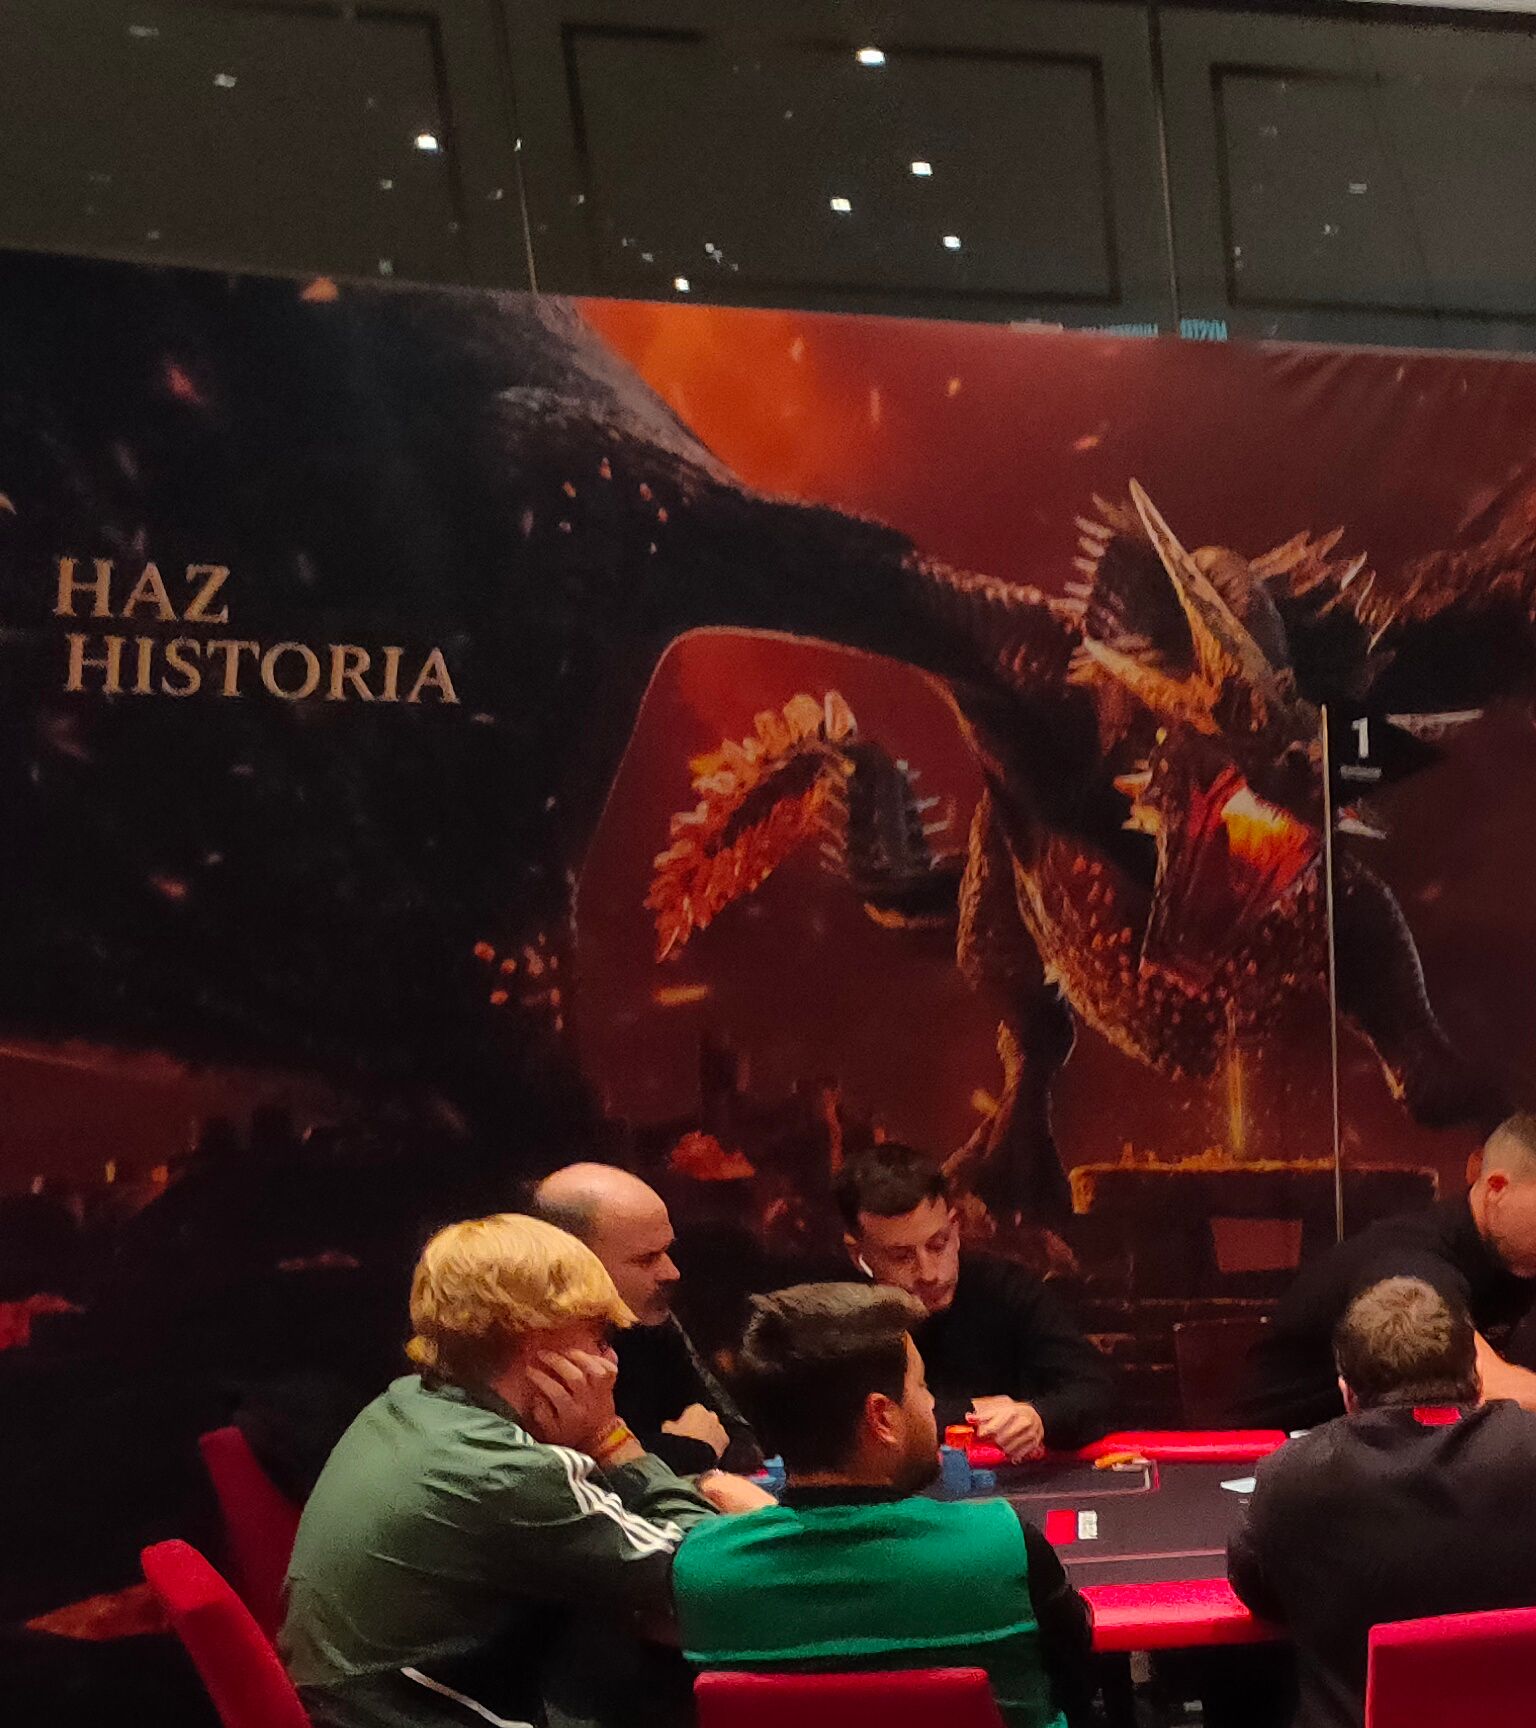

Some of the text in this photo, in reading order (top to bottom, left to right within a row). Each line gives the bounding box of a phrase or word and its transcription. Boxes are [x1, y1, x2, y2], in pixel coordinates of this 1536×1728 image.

[52, 556, 230, 624] HAZ
[63, 633, 460, 704] HISTORIA
[1351, 717, 1369, 759] 1
